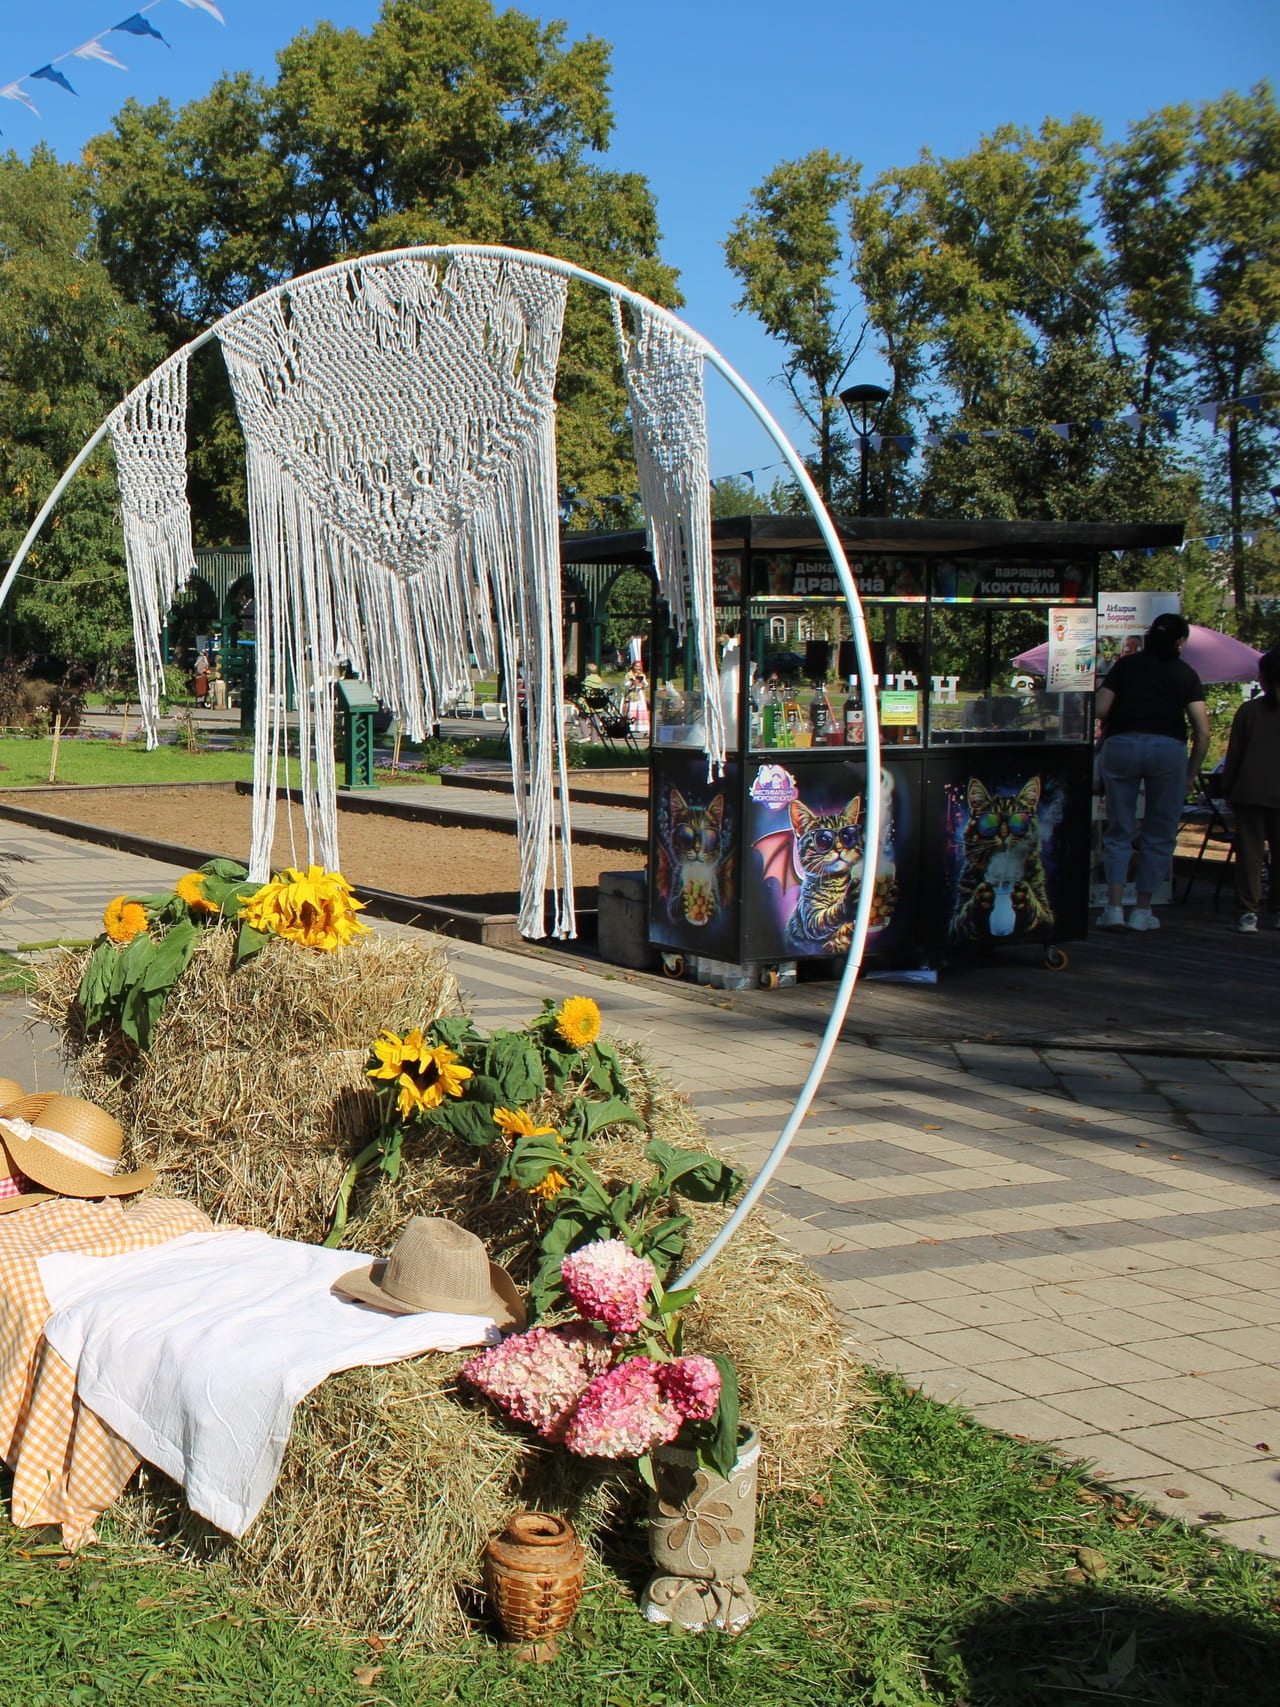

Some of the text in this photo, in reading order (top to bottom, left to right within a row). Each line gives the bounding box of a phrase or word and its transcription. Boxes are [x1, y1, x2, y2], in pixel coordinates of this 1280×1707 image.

[795, 561, 864, 575] дыхае
[994, 567, 1056, 579] парящие
[980, 580, 1060, 594] коктейли
[1107, 612, 1136, 622] Бодиарт
